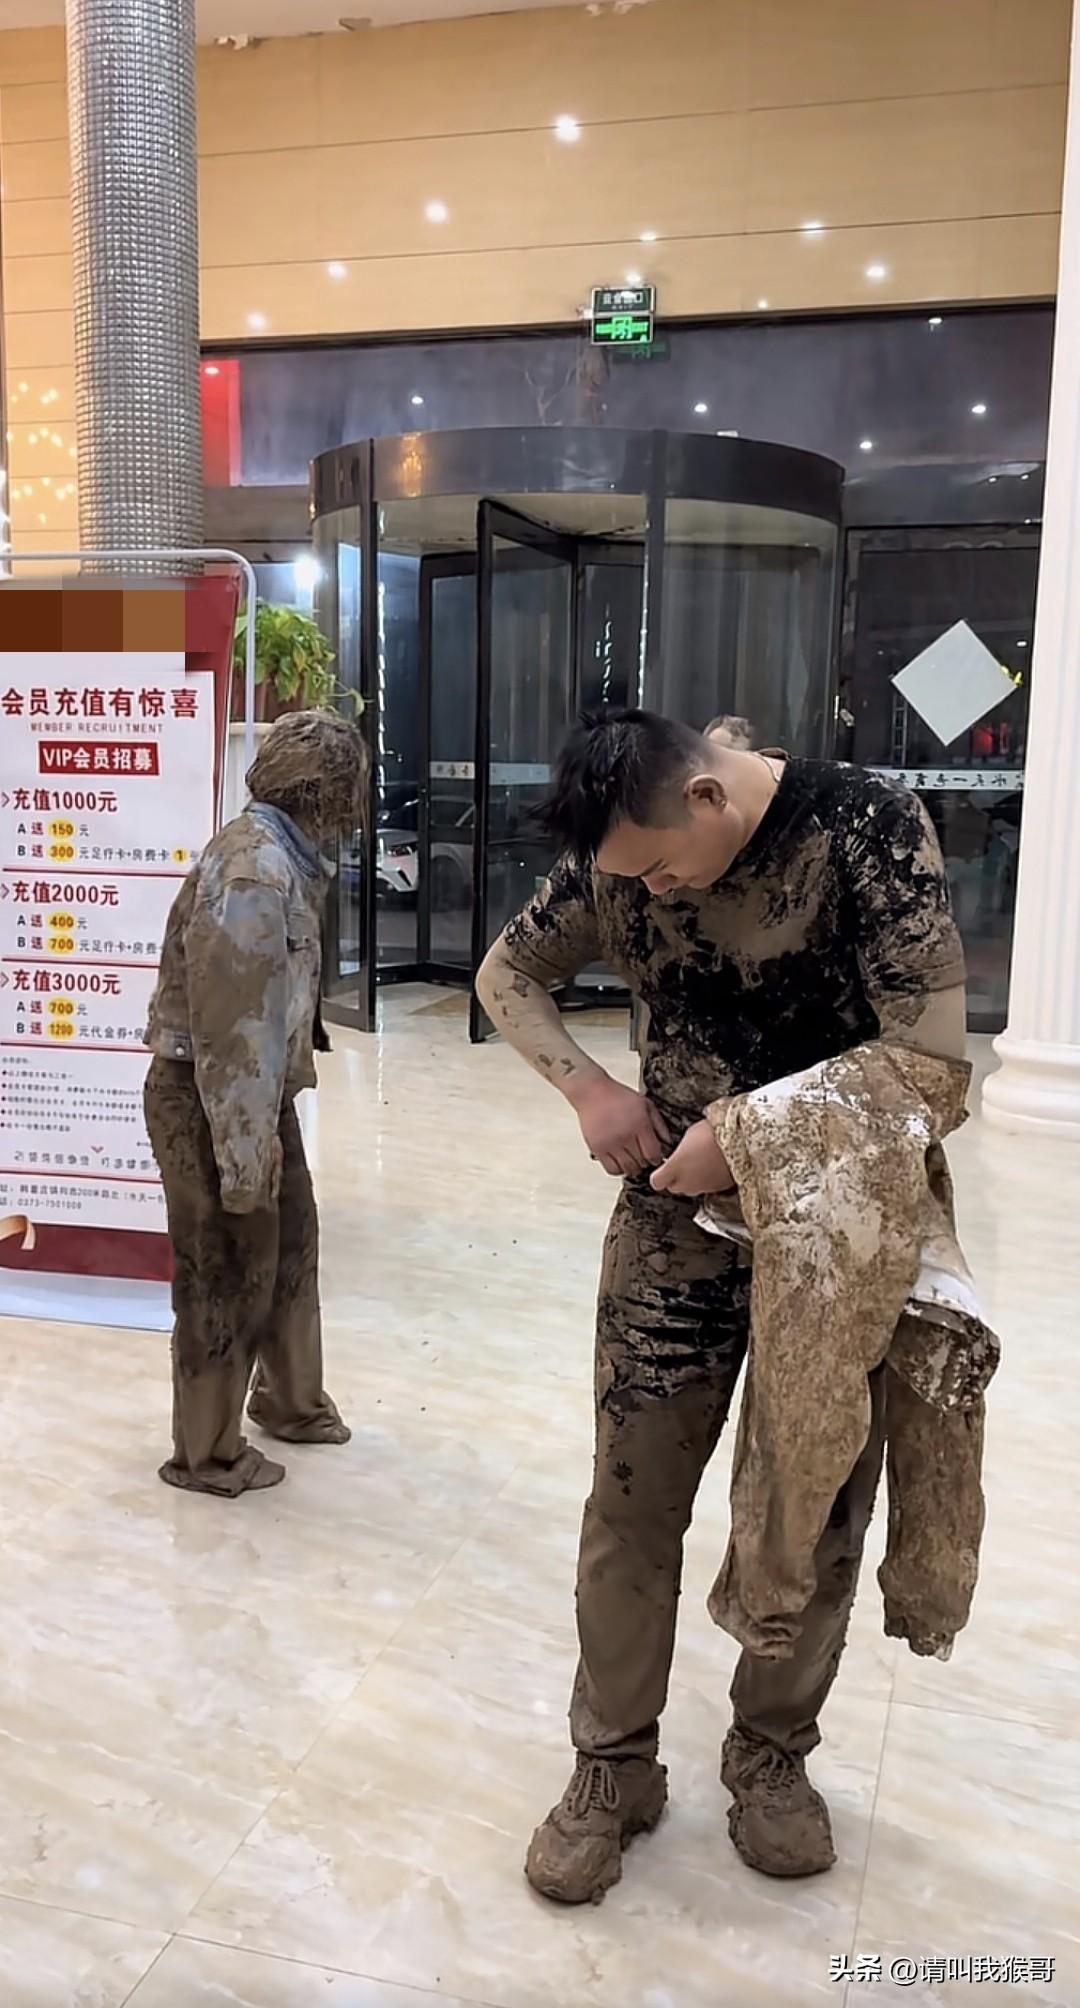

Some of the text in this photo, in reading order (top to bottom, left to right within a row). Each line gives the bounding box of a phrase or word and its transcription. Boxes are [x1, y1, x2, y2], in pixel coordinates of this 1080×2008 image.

[2, 687, 198, 718] 会员充值有惊喜
[43, 746, 153, 771] VIP会员招募
[13, 788, 117, 812] 充值1000元
[17, 822, 89, 836] A 送 150 元
[17, 845, 26, 856] B
[31, 844, 44, 857] 送
[49, 845, 74, 857] 300
[13, 880, 119, 905] 充值2000元
[17, 914, 88, 930] A 送 400 元
[17, 936, 162, 955] B 送 700 元足疗卡+房费
[13, 969, 121, 995] 充值3000元
[16, 1000, 88, 1016] A 送 700 元
[16, 1023, 25, 1034] B
[30, 1021, 43, 1035] 送
[49, 1023, 73, 1035] 1200
